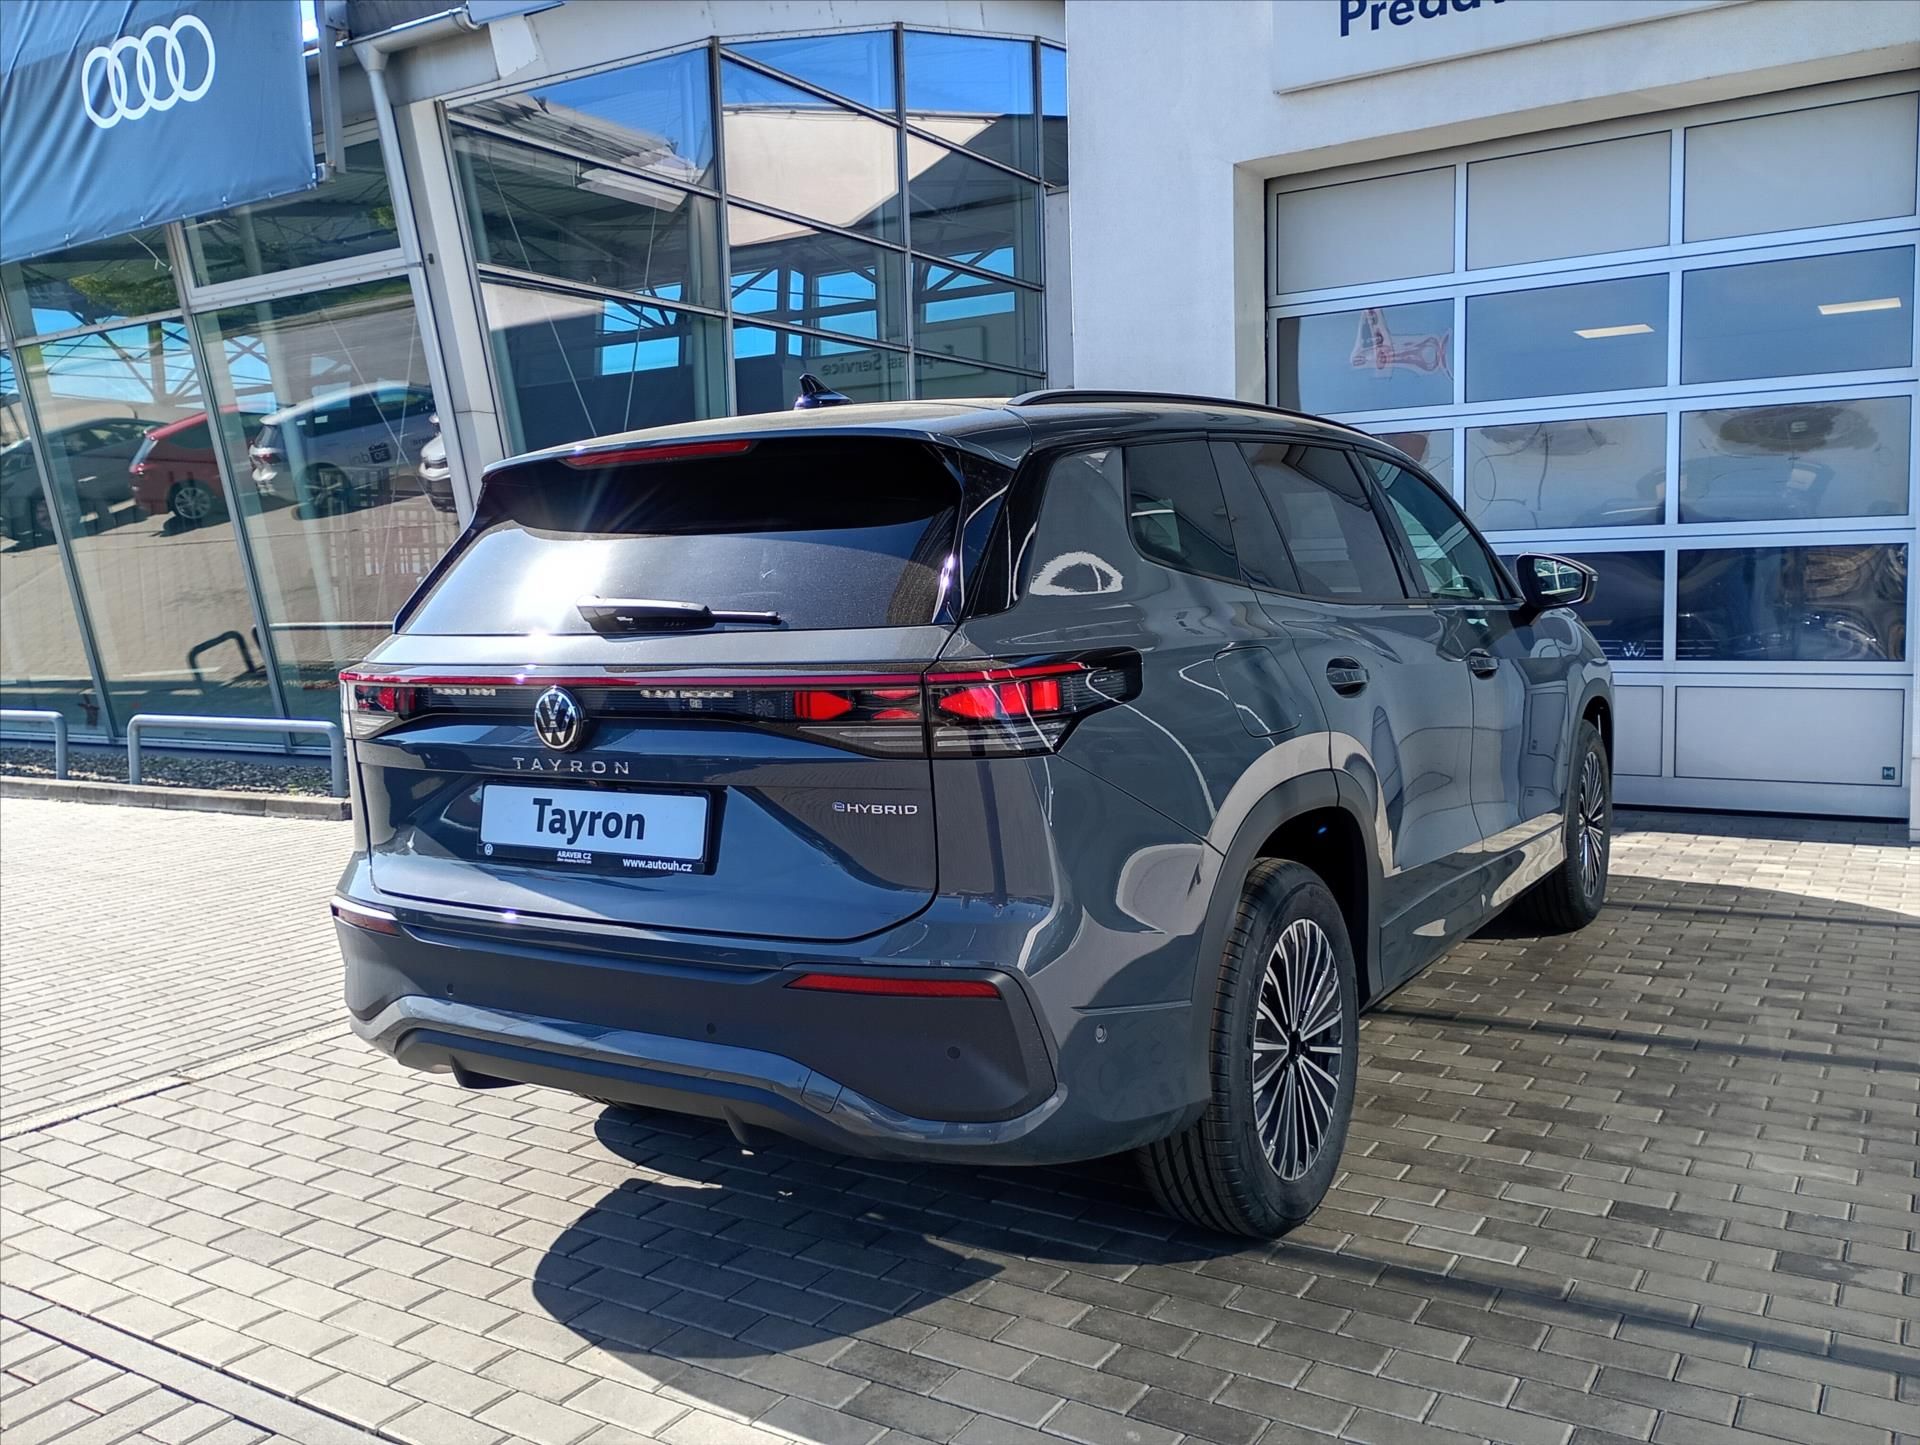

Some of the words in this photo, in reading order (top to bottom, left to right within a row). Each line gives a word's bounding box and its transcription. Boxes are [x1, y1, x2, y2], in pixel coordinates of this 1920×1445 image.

[513, 757, 629, 774] TAYRON
[832, 802, 918, 815] eHYBRID
[533, 798, 645, 844] Tayron
[557, 850, 582, 859] ARAVER
[583, 852, 592, 860] CZ
[622, 858, 692, 872] www.autouh.cz
